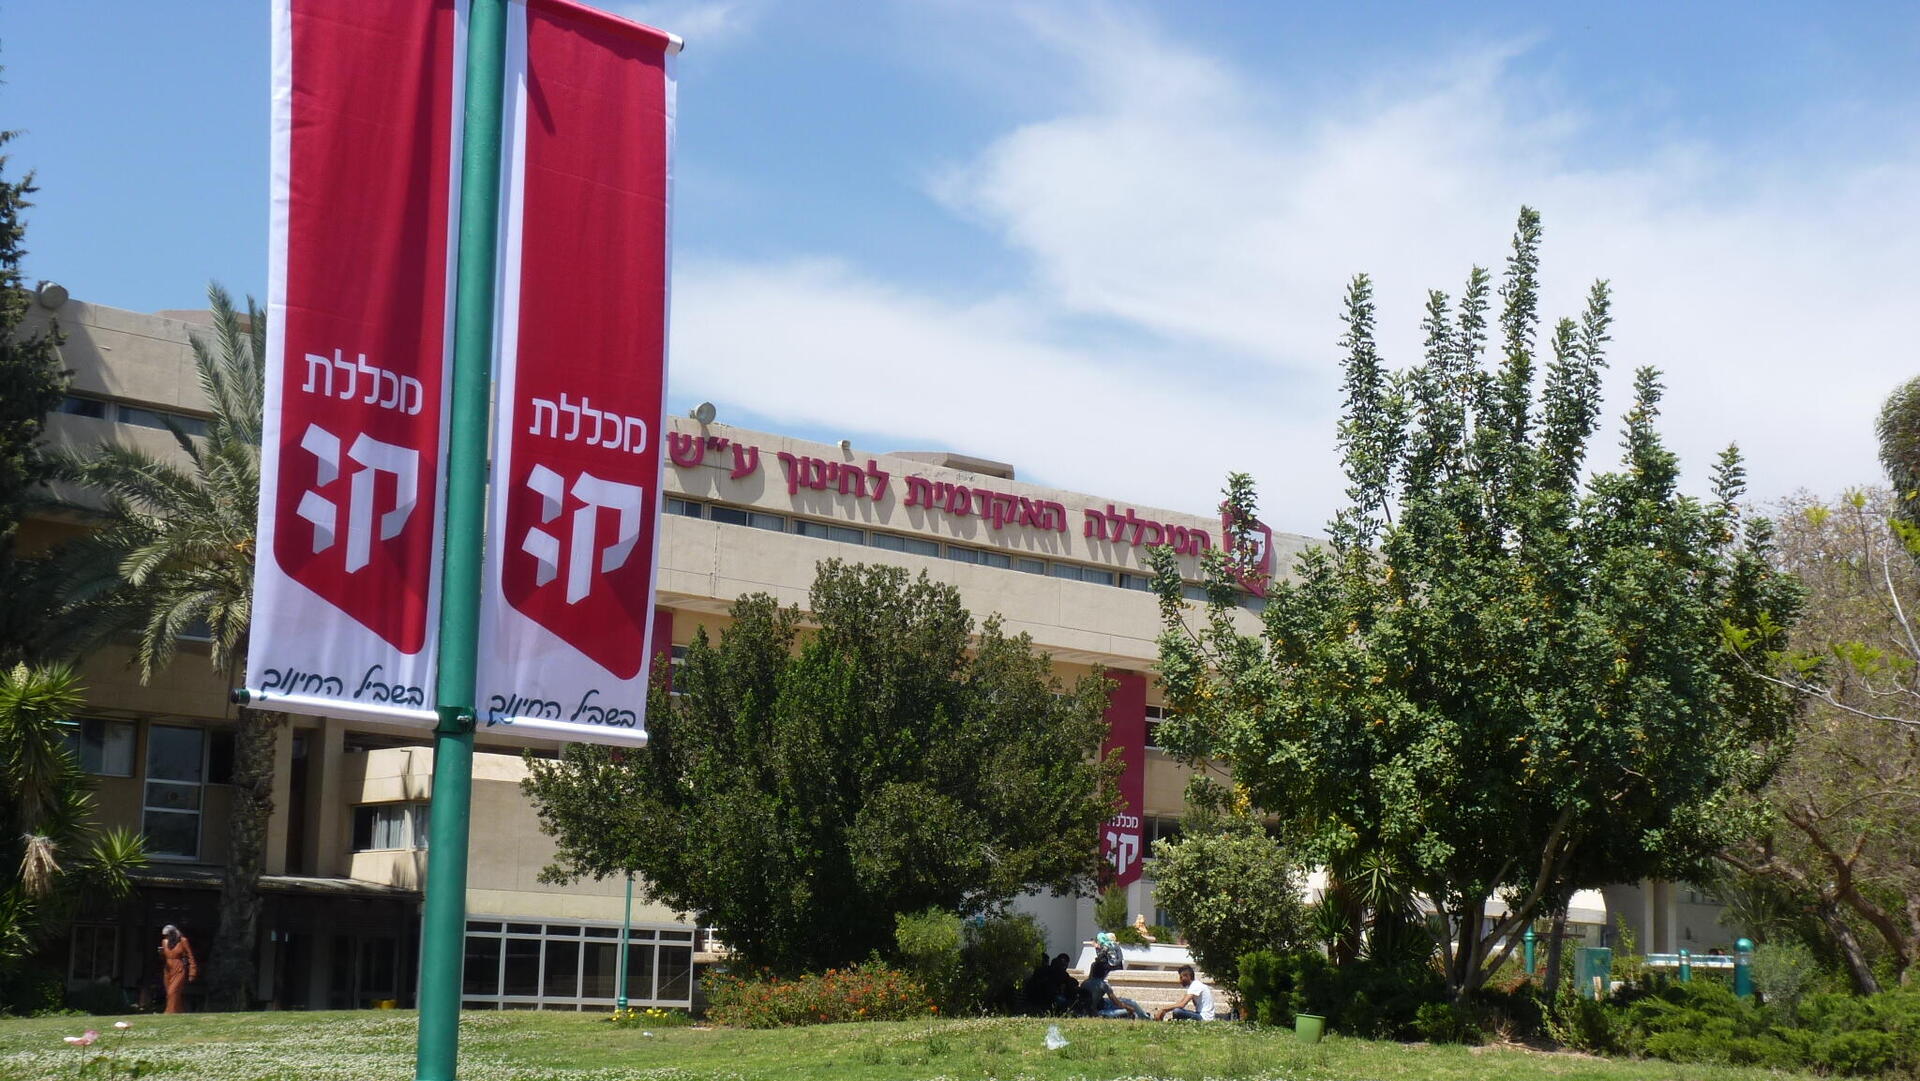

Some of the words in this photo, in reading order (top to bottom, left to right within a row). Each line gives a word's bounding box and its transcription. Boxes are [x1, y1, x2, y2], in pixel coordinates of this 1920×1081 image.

[303, 348, 423, 416] מכללת
[529, 392, 647, 455] מכללת
[777, 452, 890, 501] לחינוך
[904, 475, 1066, 533] האקדמית
[1084, 504, 1211, 557] המכללה
[259, 668, 343, 702] החינוך
[354, 665, 424, 706] בשביל
[571, 689, 637, 728] בשביל
[487, 695, 562, 728] החינוך
